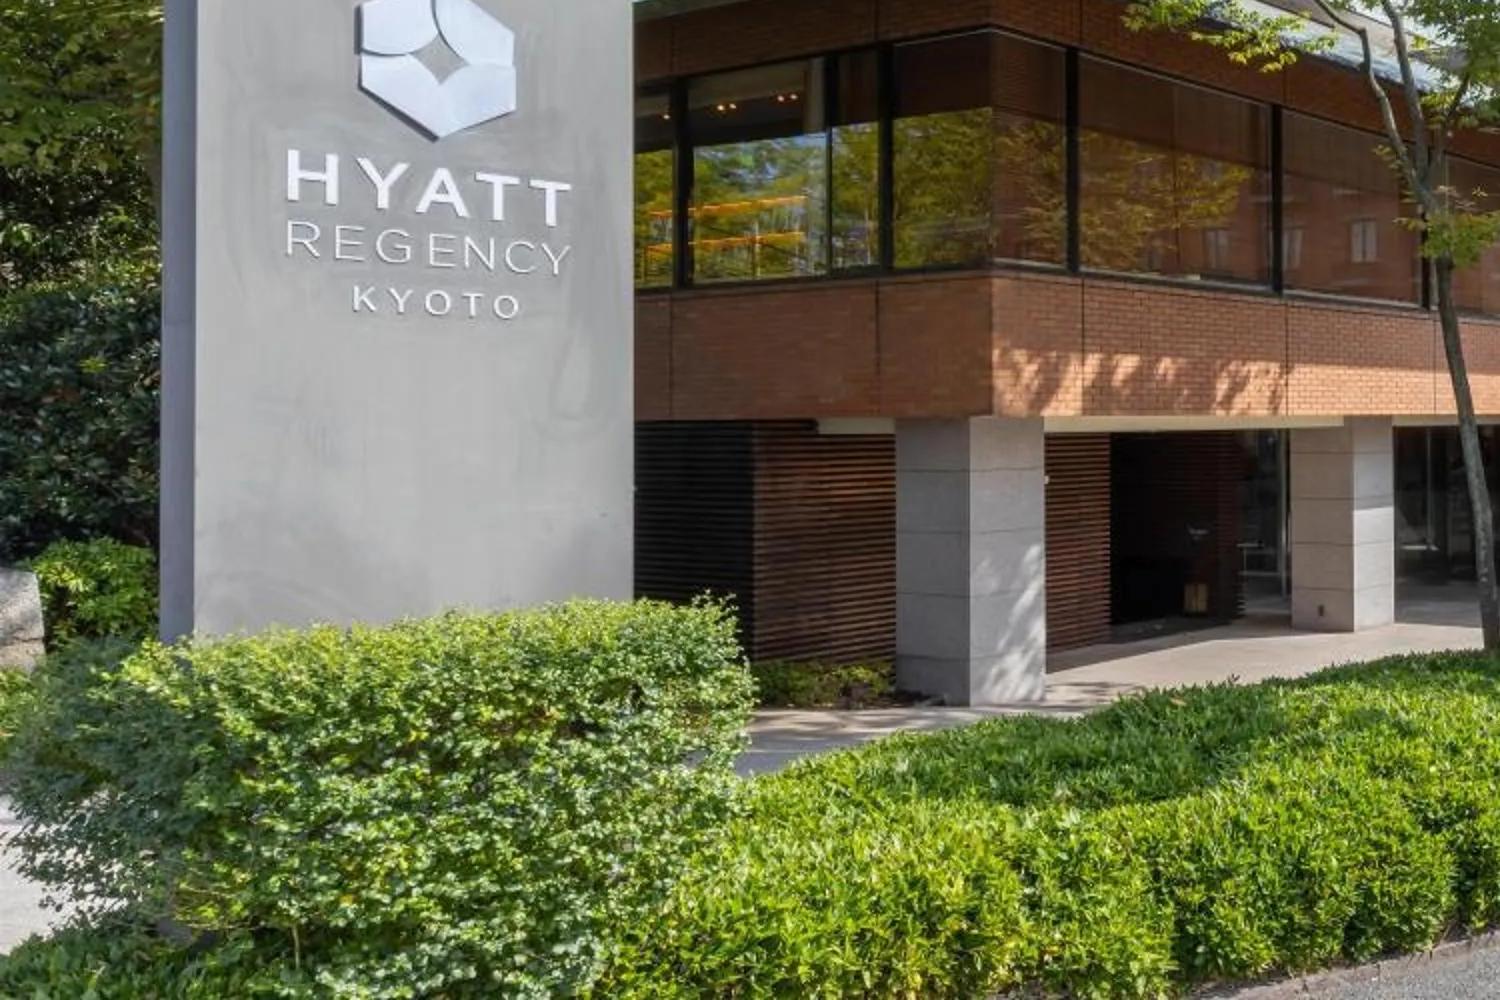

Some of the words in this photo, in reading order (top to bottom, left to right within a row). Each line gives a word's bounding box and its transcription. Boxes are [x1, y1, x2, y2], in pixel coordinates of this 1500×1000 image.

[287, 149, 572, 227] HYATT
[286, 220, 571, 275] REGENCY
[352, 285, 519, 320] KYOTO
